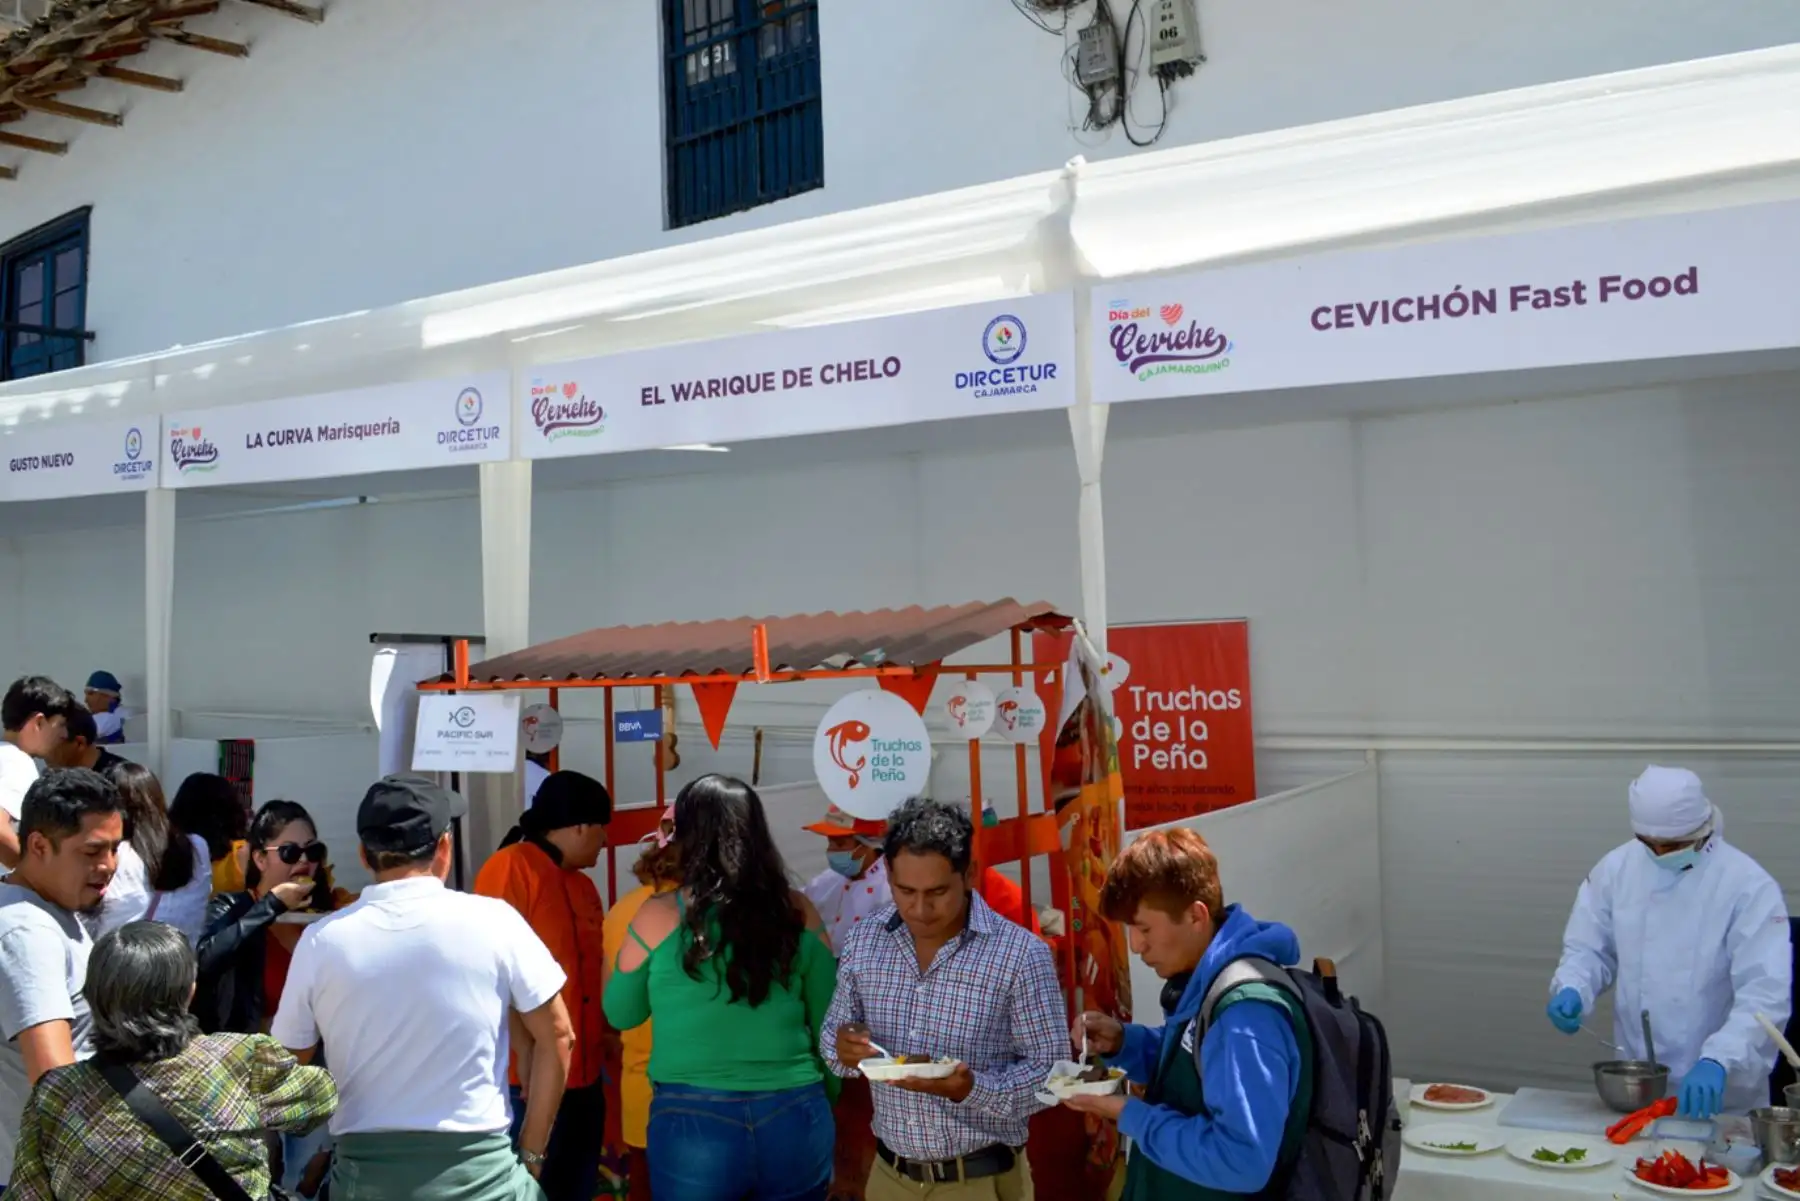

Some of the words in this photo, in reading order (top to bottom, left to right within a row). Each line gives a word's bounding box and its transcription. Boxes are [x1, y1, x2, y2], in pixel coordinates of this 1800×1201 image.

[1310, 285, 1497, 331] CEVICHÓN
[1510, 280, 1587, 312] Fast
[1599, 266, 1699, 303] Food
[1110, 320, 1226, 374] Ceviche
[641, 386, 666, 406] EL
[671, 371, 776, 402] WARIQUE
[782, 367, 813, 390] DE
[819, 356, 901, 385] CHELO
[955, 363, 1057, 389] DIRCETUR
[1138, 358, 1230, 381] CAJAMARQUINO
[974, 384, 1037, 398] CAJAMARCA
[246, 433, 263, 449] LA
[267, 426, 313, 447] CURVA
[317, 416, 400, 442] Marisquería
[437, 426, 500, 444] DIRCETUR
[10, 456, 39, 472] GUSTO
[41, 452, 74, 468] NUEVO
[114, 460, 152, 474] DIRCETUR
[1128, 684, 1242, 712] Truchas
[437, 730, 473, 738] PACIFIC
[1132, 715, 1170, 741] de
[1179, 715, 1208, 741] la
[870, 738, 922, 752] Truchas
[1134, 743, 1208, 770] Peña
[871, 753, 890, 767] de
[892, 753, 905, 766] la
[871, 768, 906, 782] Peña
